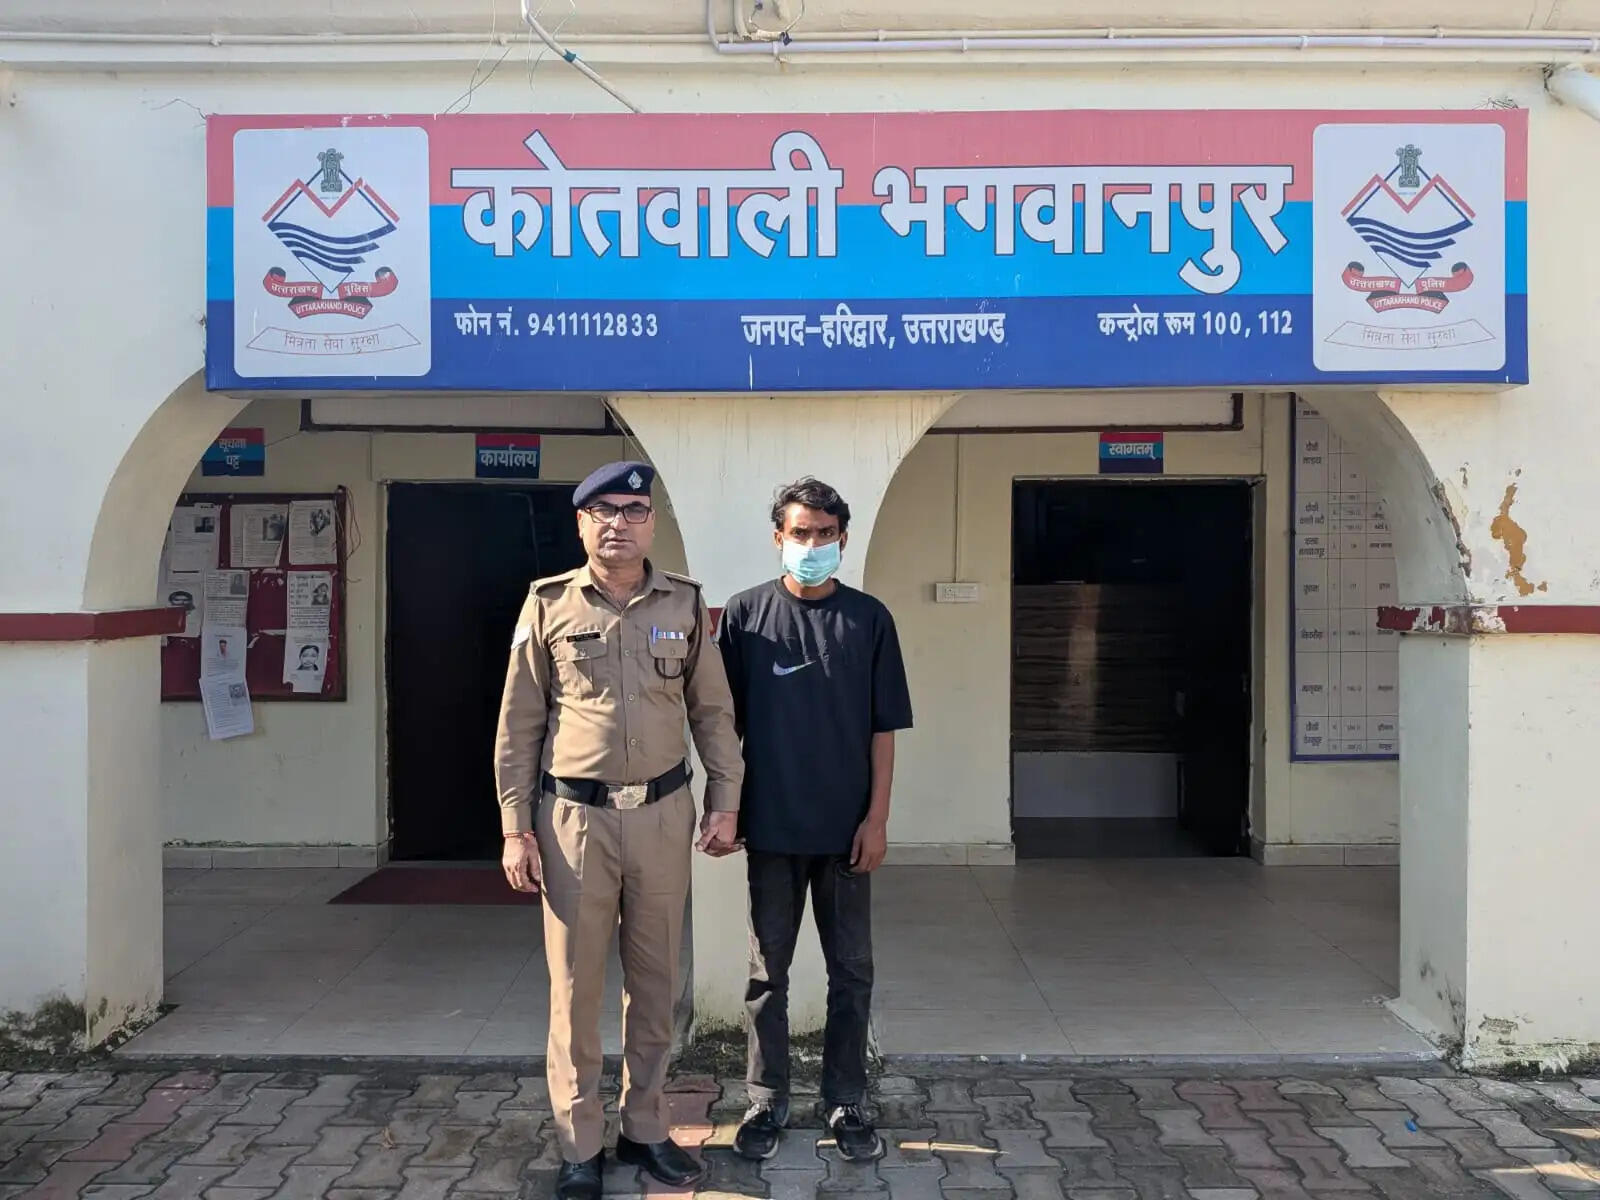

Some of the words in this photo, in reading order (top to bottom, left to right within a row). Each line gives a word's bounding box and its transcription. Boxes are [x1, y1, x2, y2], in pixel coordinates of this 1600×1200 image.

[451, 129, 844, 258] कोतवाली
[872, 164, 1294, 295] भगवानपुर
[296, 300, 342, 314] UTTARAKHAND
[343, 302, 366, 316] POLICE
[1374, 296, 1419, 309] UTTARAKHAND
[1420, 297, 1443, 311] POLICE
[454, 304, 491, 336] फोन
[496, 306, 520, 337] नं.
[528, 312, 658, 338] 9411112833
[902, 311, 1006, 345] उत्तराखण्ड
[1097, 304, 1159, 341] कन्ट्रोल
[1164, 310, 1195, 336] रूम
[1258, 310, 1293, 336] 112
[284, 332, 316, 351] मित्रता
[324, 332, 344, 350] सेवा
[351, 332, 380, 354] सुरक्षा
[1400, 328, 1420, 345] सेवा
[478, 443, 538, 468] कार्यालय
[1108, 442, 1156, 460] स्वागतम्
